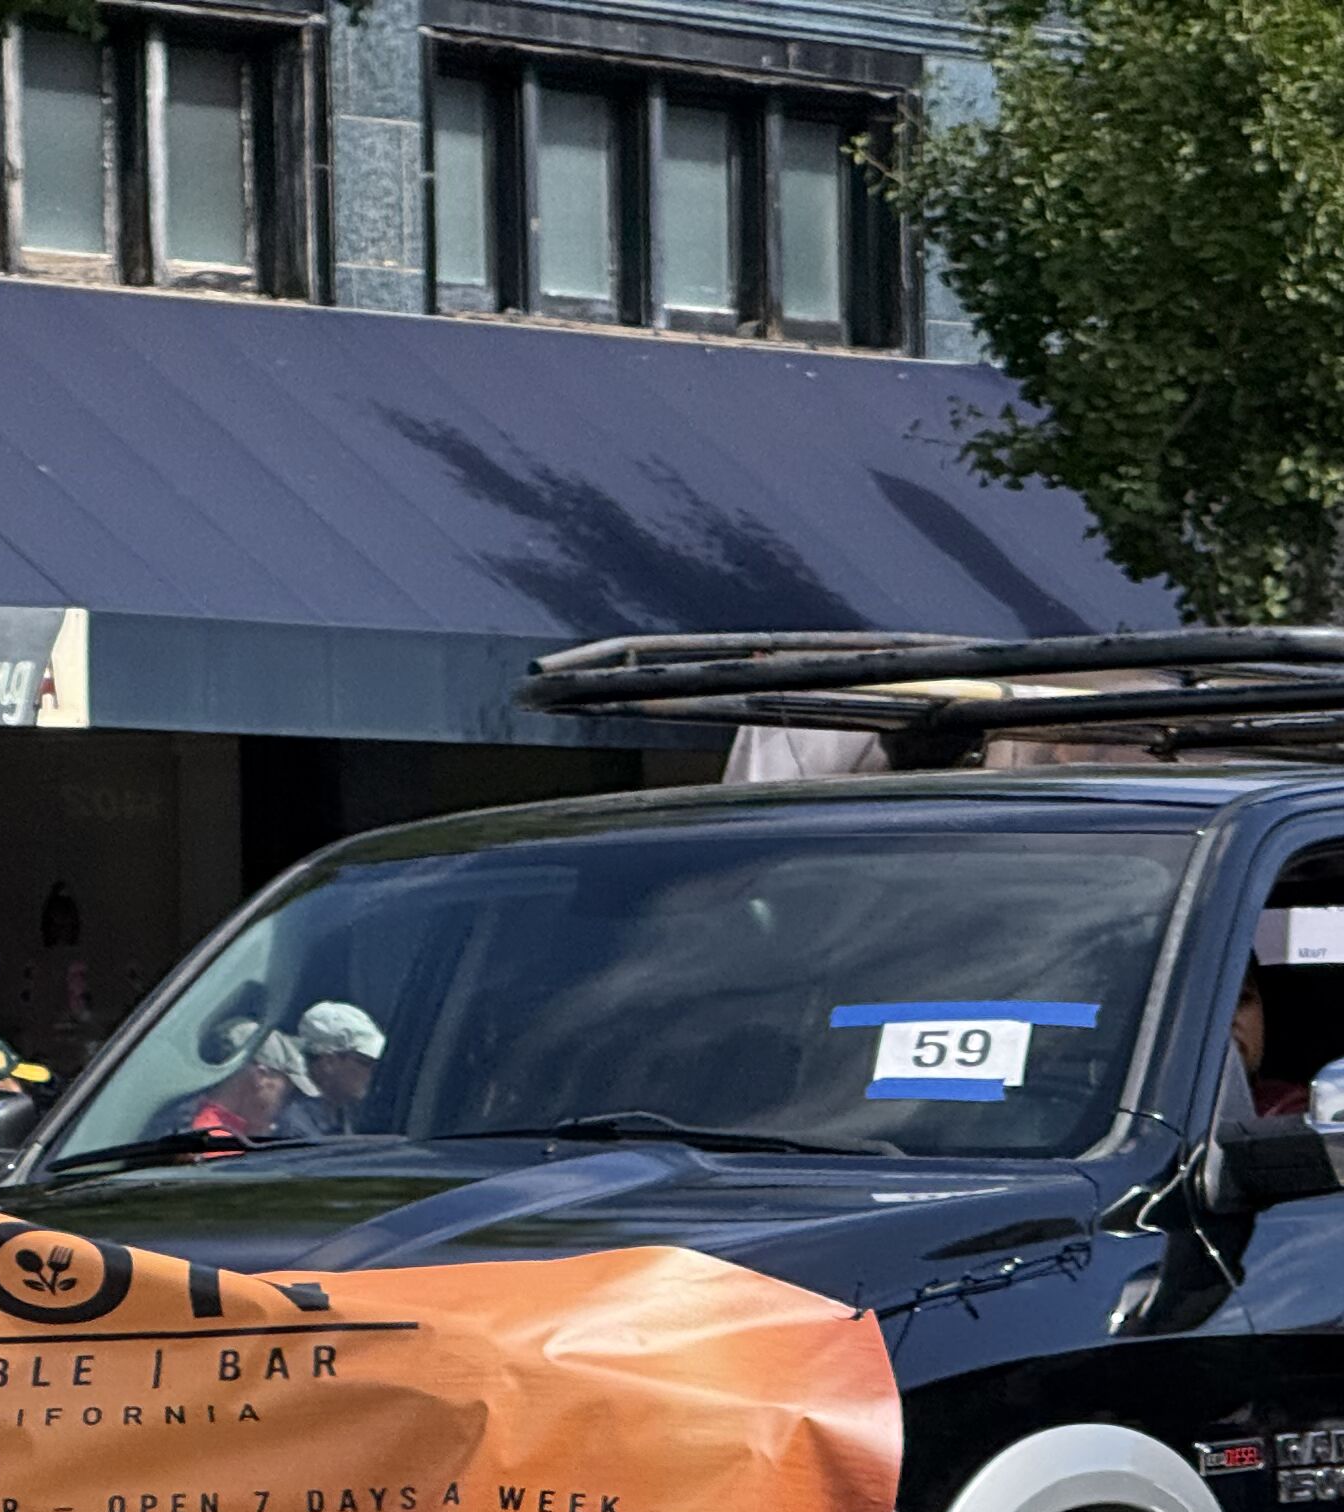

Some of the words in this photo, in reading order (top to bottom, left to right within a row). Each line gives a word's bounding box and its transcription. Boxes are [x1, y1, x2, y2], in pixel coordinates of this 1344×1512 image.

[911, 1028, 992, 1068] 59
[218, 1344, 339, 1382] BAR
[441, 1481, 461, 1506] A
